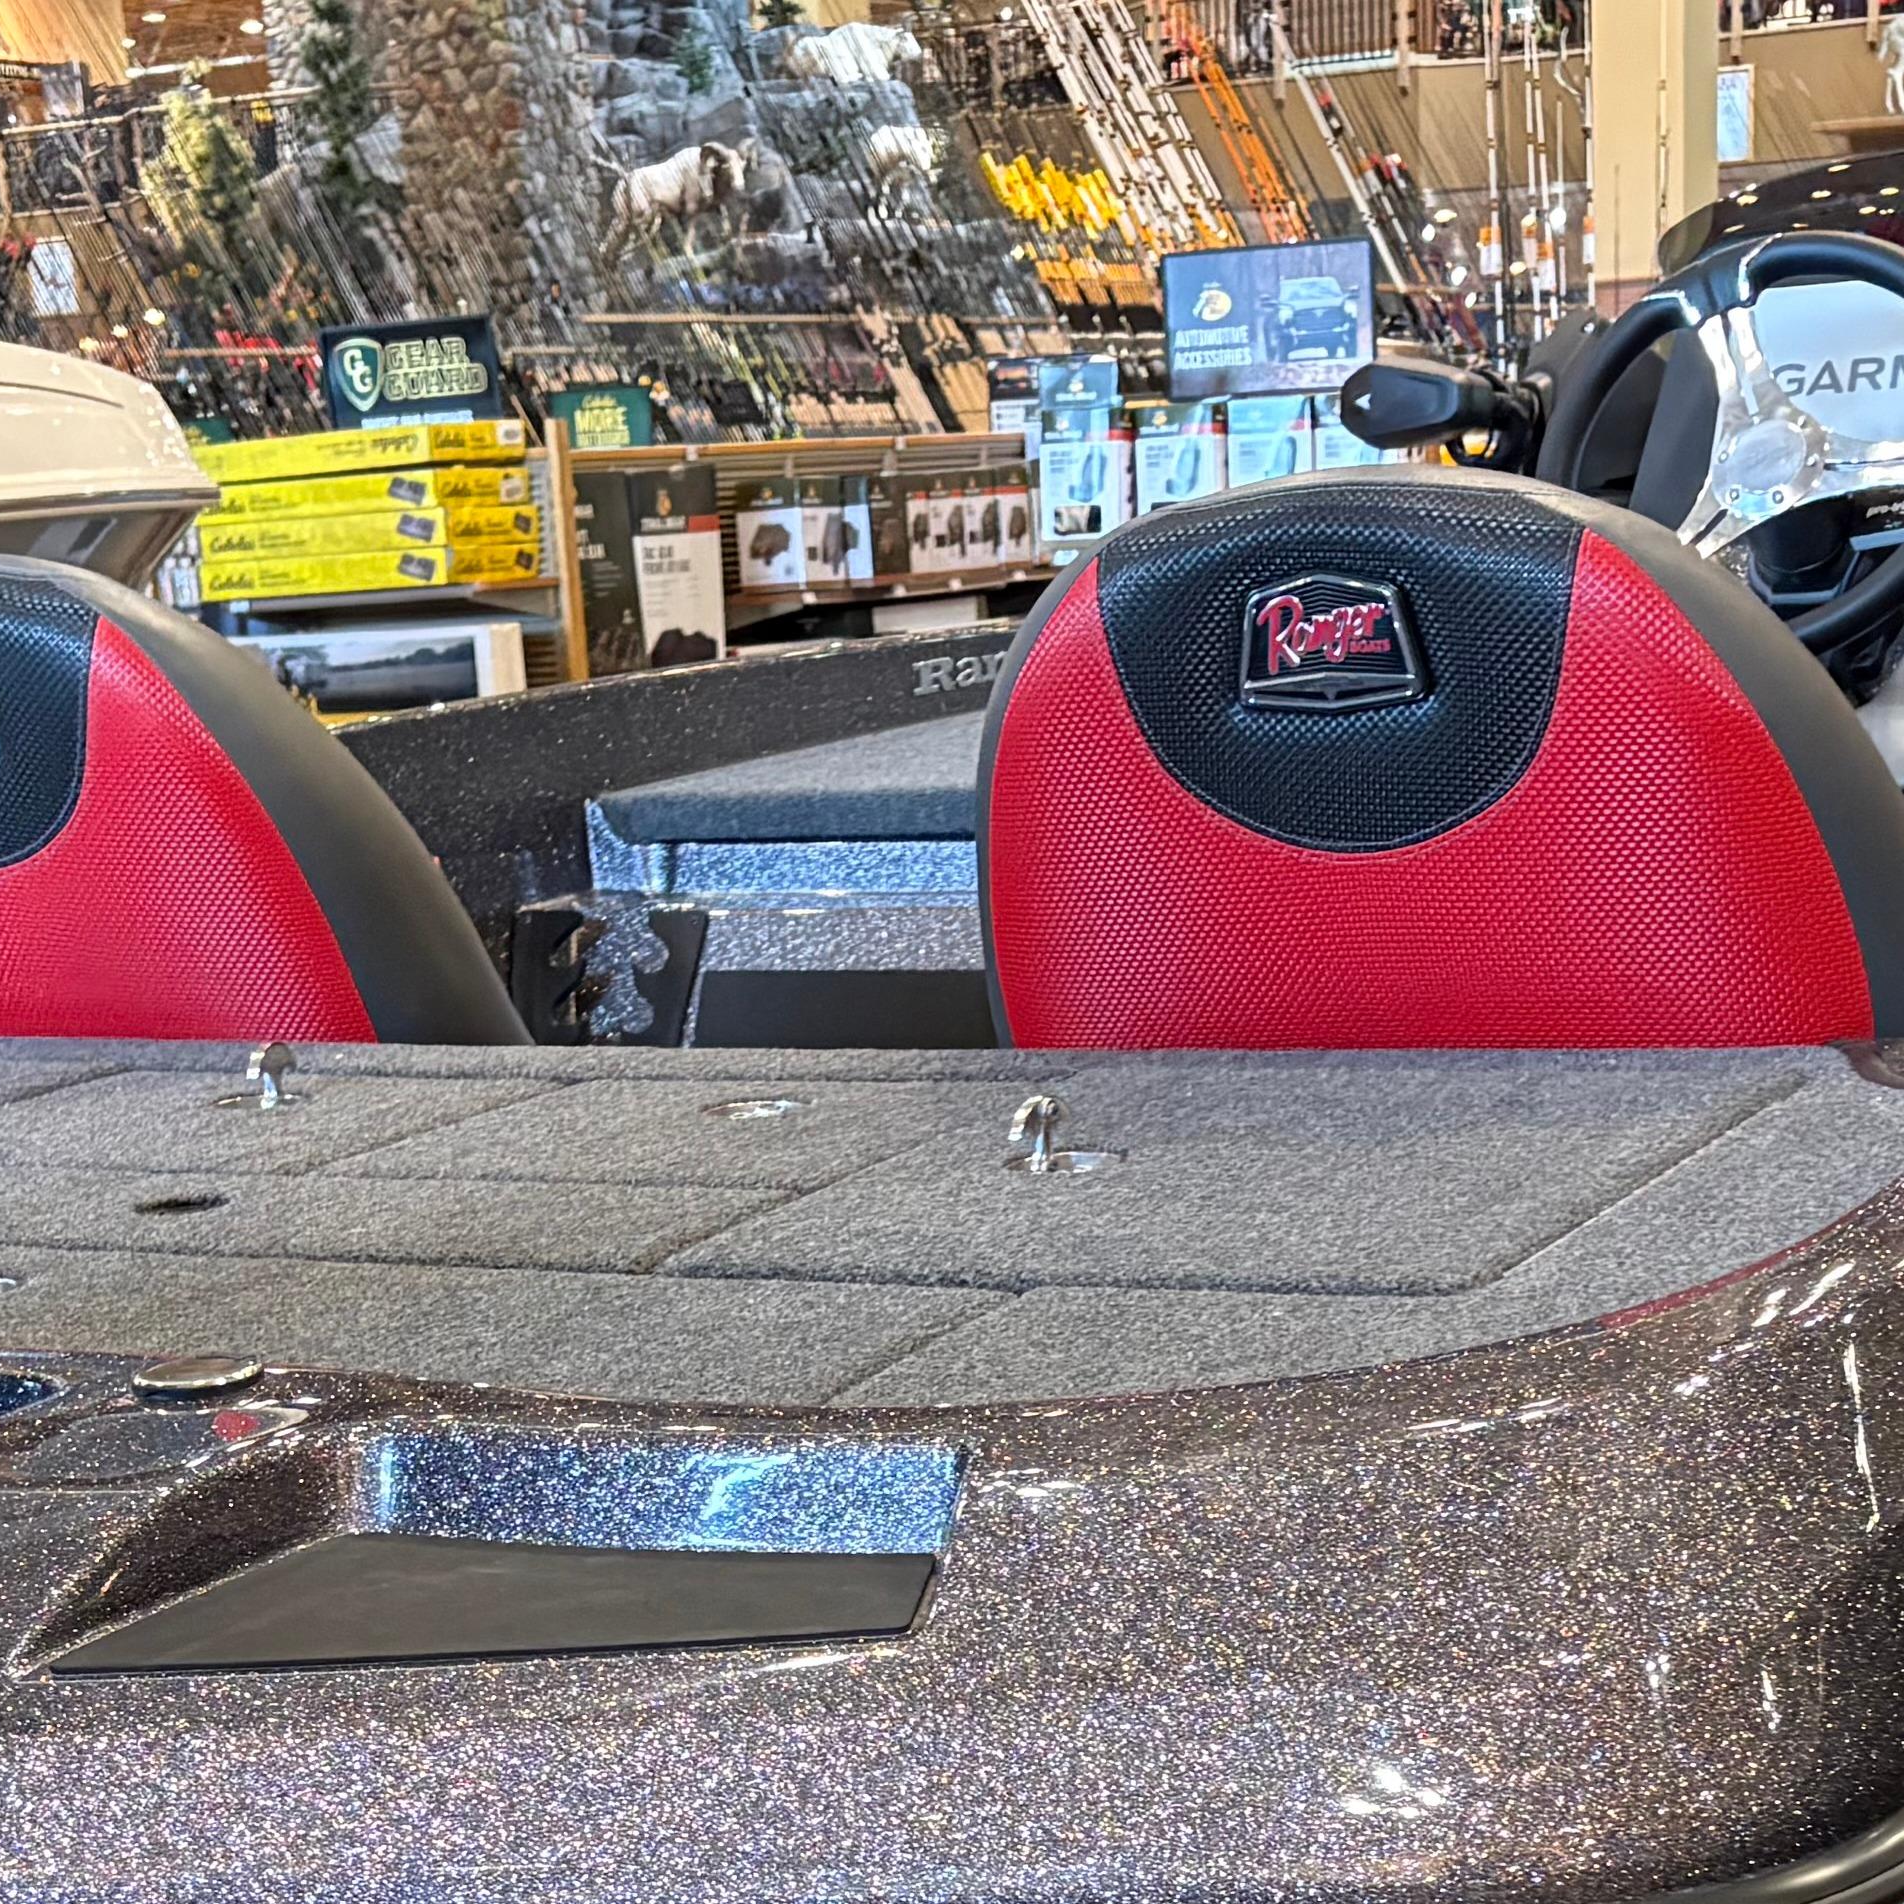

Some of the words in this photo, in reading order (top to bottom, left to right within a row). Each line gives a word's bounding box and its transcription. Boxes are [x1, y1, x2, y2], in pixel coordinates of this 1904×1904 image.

[384, 336, 469, 369] GEAR
[383, 363, 489, 402] GUARD
[1256, 595, 1385, 675] Ranger
